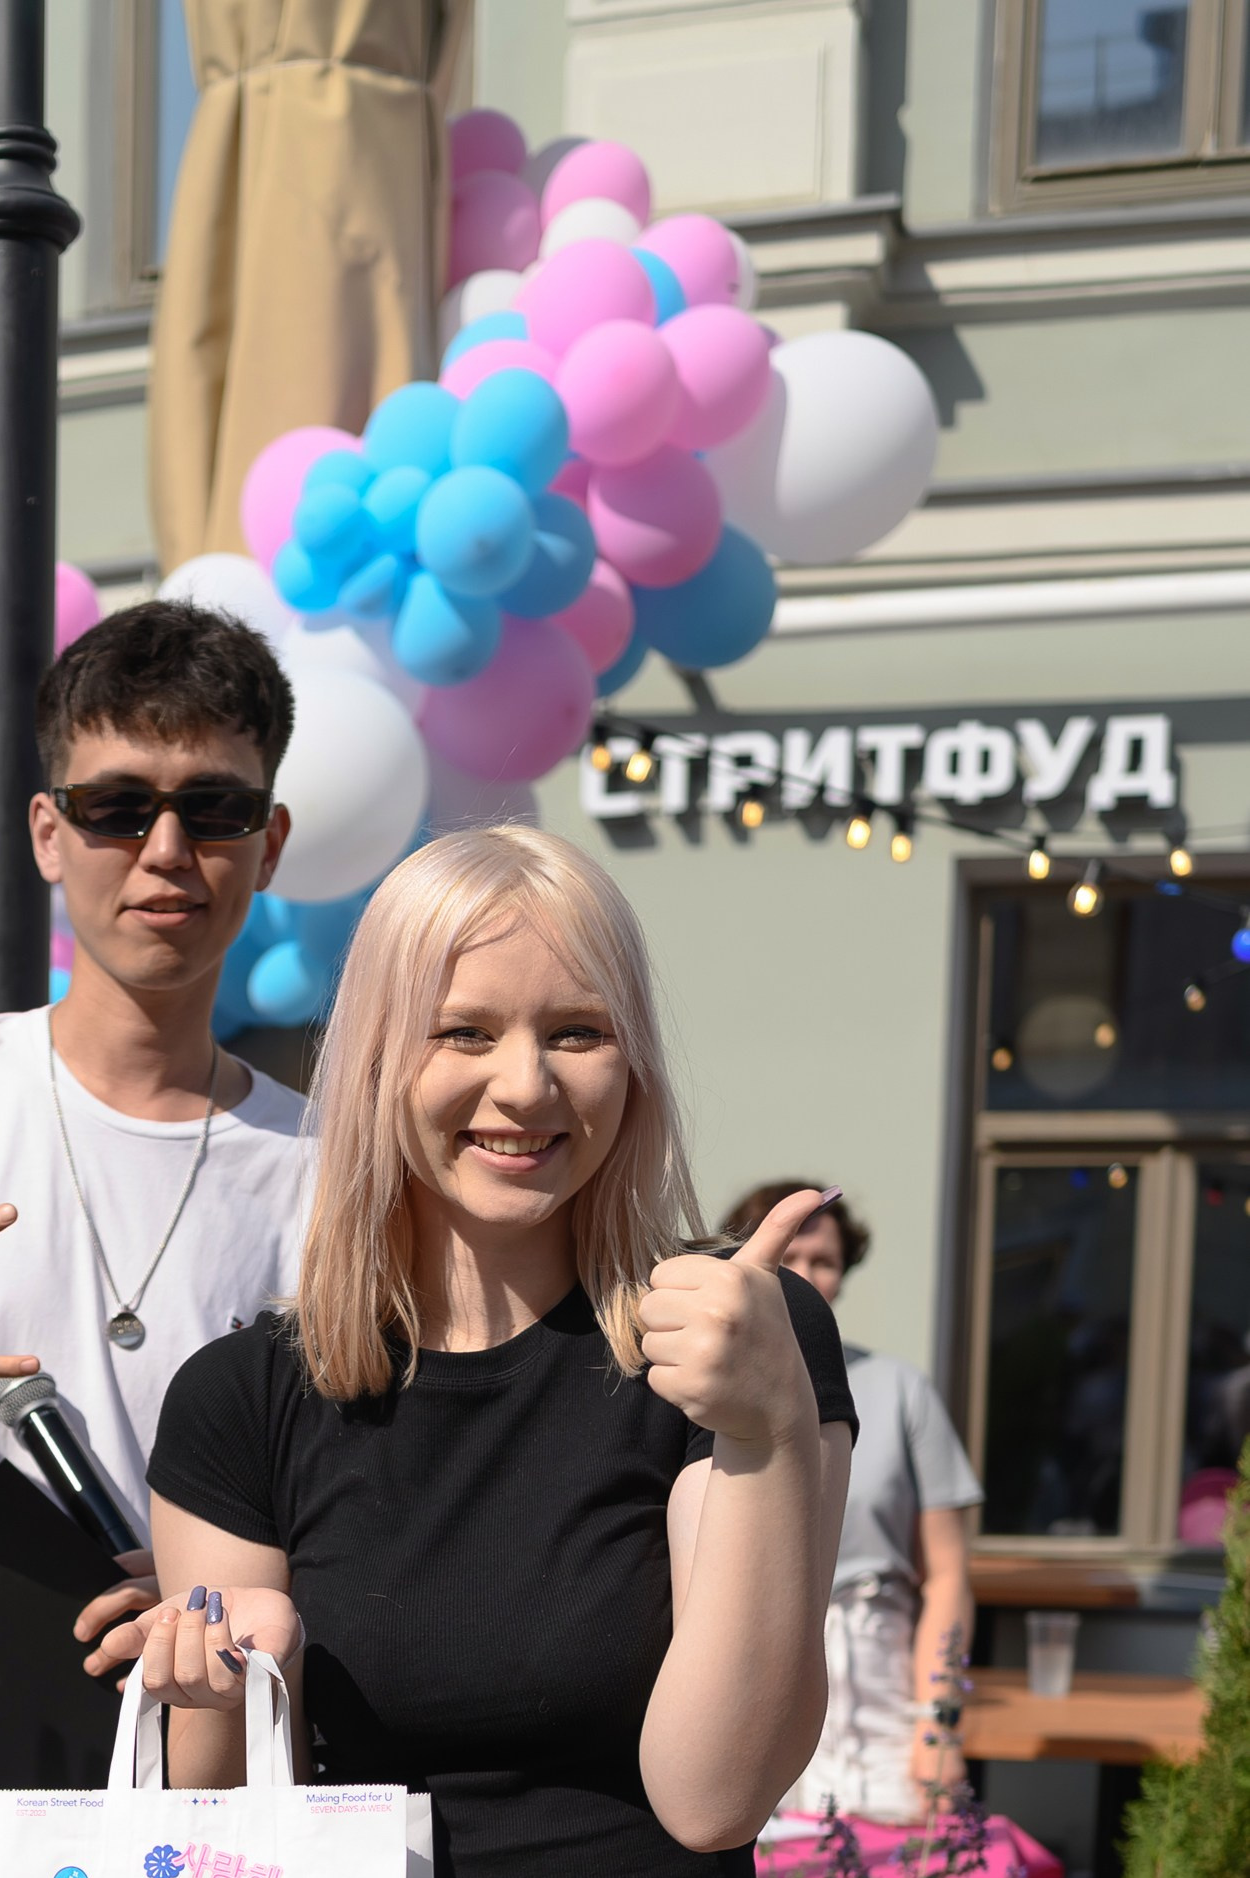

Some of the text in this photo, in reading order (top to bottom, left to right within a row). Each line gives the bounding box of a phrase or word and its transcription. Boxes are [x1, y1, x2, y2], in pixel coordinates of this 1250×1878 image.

[581, 713, 1177, 818] СТРИТФУД
[16, 1798, 104, 1808] Korean Street Food
[306, 1791, 393, 1805] Making Food for U
[310, 1806, 337, 1814] SEVEN
[338, 1805, 359, 1813] DAYS
[368, 1804, 392, 1812] WEEK
